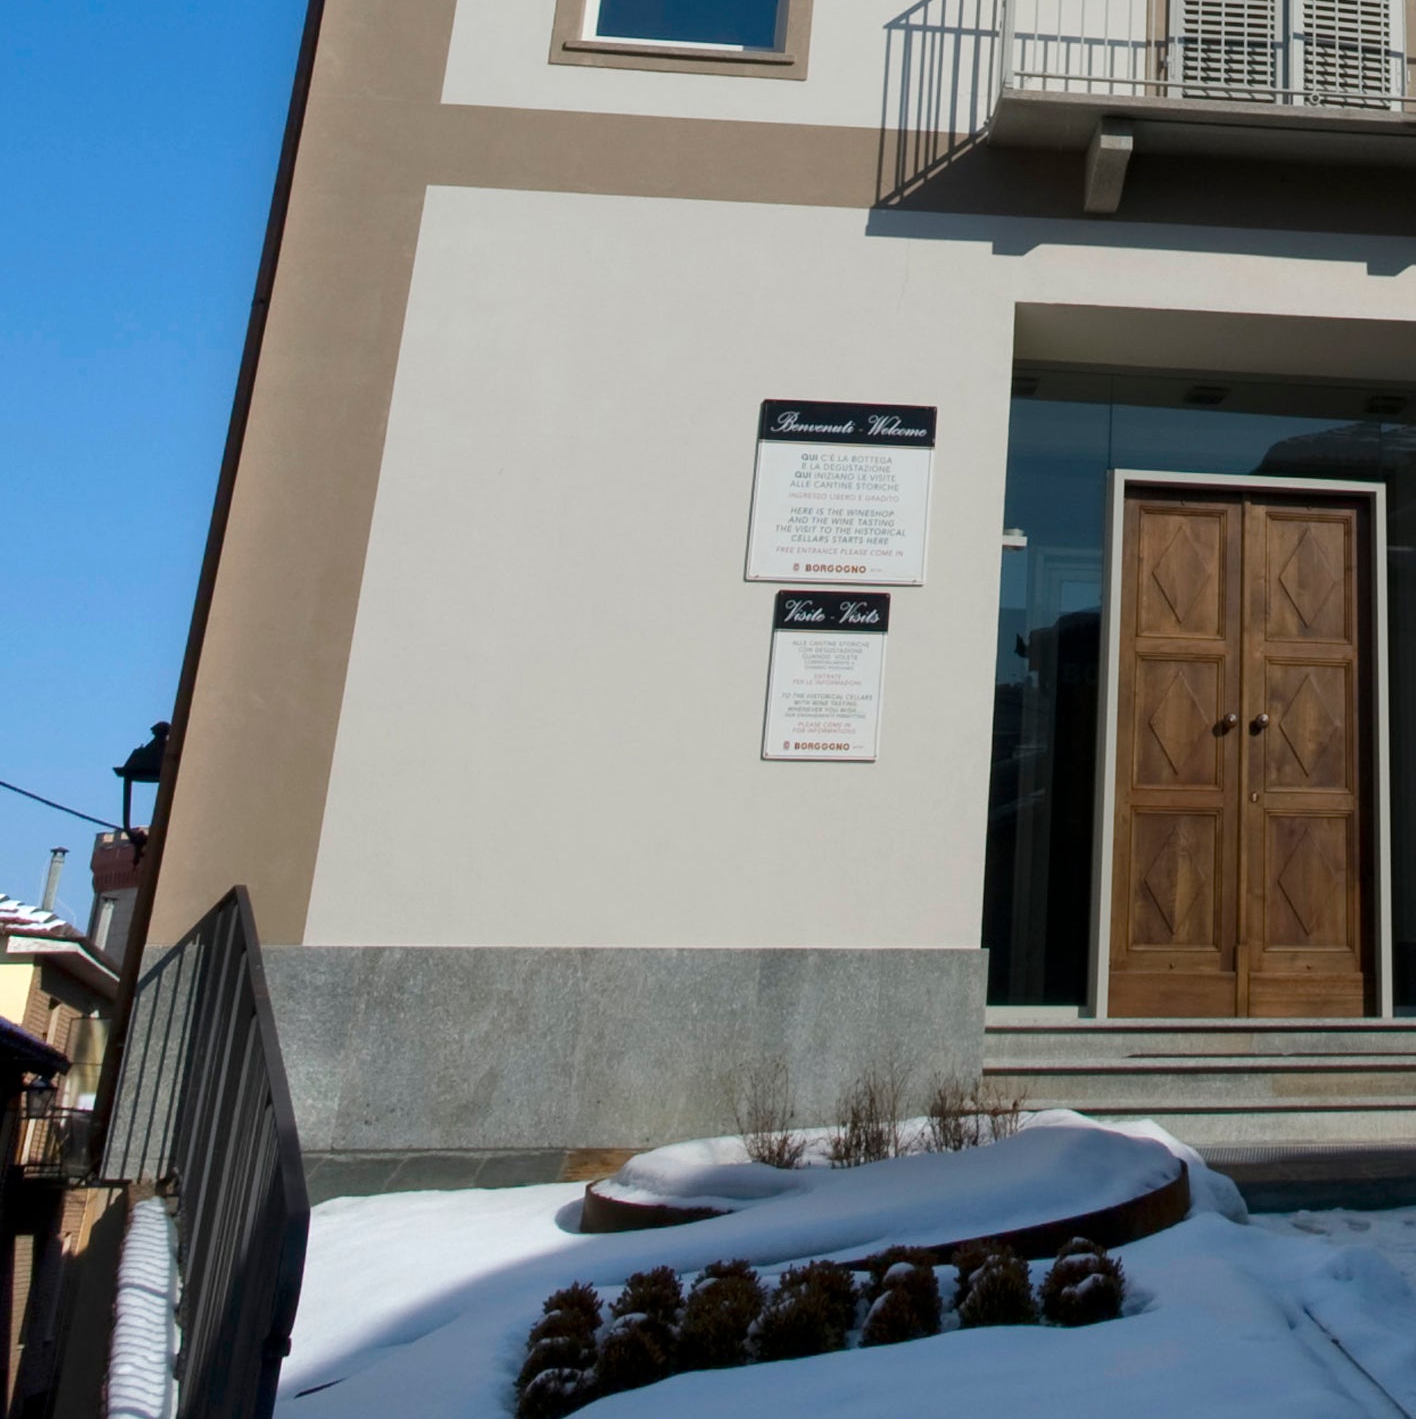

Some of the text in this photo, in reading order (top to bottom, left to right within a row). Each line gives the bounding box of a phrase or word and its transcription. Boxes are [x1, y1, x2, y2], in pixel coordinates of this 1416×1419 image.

[770, 411, 855, 433] Benvenuti
[867, 415, 927, 437] Welcome
[801, 453, 818, 461] QUI
[851, 455, 892, 464] BOTTEGA
[823, 463, 891, 473] DEGUSTAZIONE
[794, 471, 811, 479] QUI
[814, 472, 854, 481] INIZIANO
[870, 474, 896, 482] VISITE
[790, 480, 899, 492] ALLE CANTINE STORICHE
[790, 507, 895, 518] HERE IS THE WINESHOP
[788, 516, 895, 527] AND THE WINE TASTING
[776, 525, 907, 537] THE VISIT TO THE HISTORICAL
[791, 534, 889, 545] CELLARS STARTS HERE
[805, 564, 867, 574] BORGOGNO
[785, 600, 825, 623] Visite
[839, 602, 880, 623] Visits
[794, 742, 850, 751] BORGOGNO
